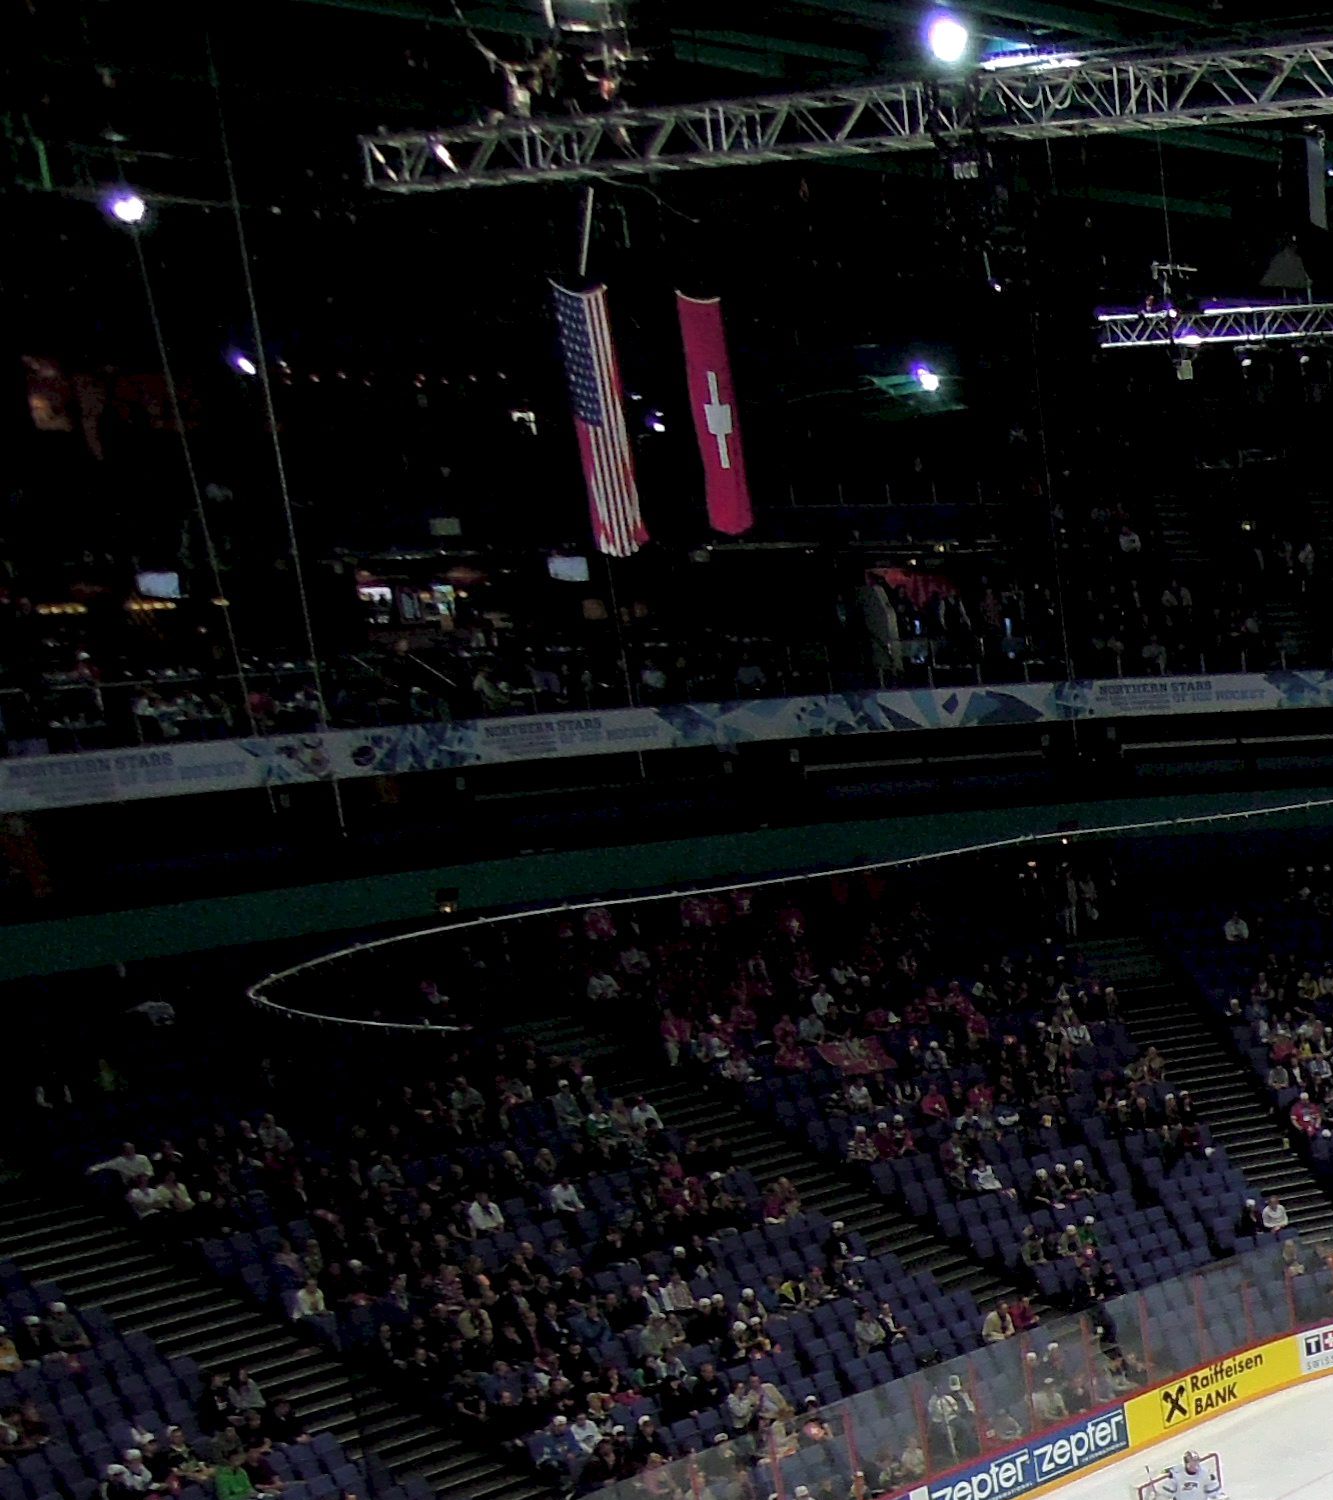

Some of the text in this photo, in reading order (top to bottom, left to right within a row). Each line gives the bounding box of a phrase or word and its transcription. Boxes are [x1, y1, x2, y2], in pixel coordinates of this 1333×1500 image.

[1099, 684, 1167, 696] NORTHERN
[1190, 1351, 1263, 1393] Raiffeisen
[1194, 1383, 1237, 1416] BANK
[1034, 1414, 1124, 1473] zepter
